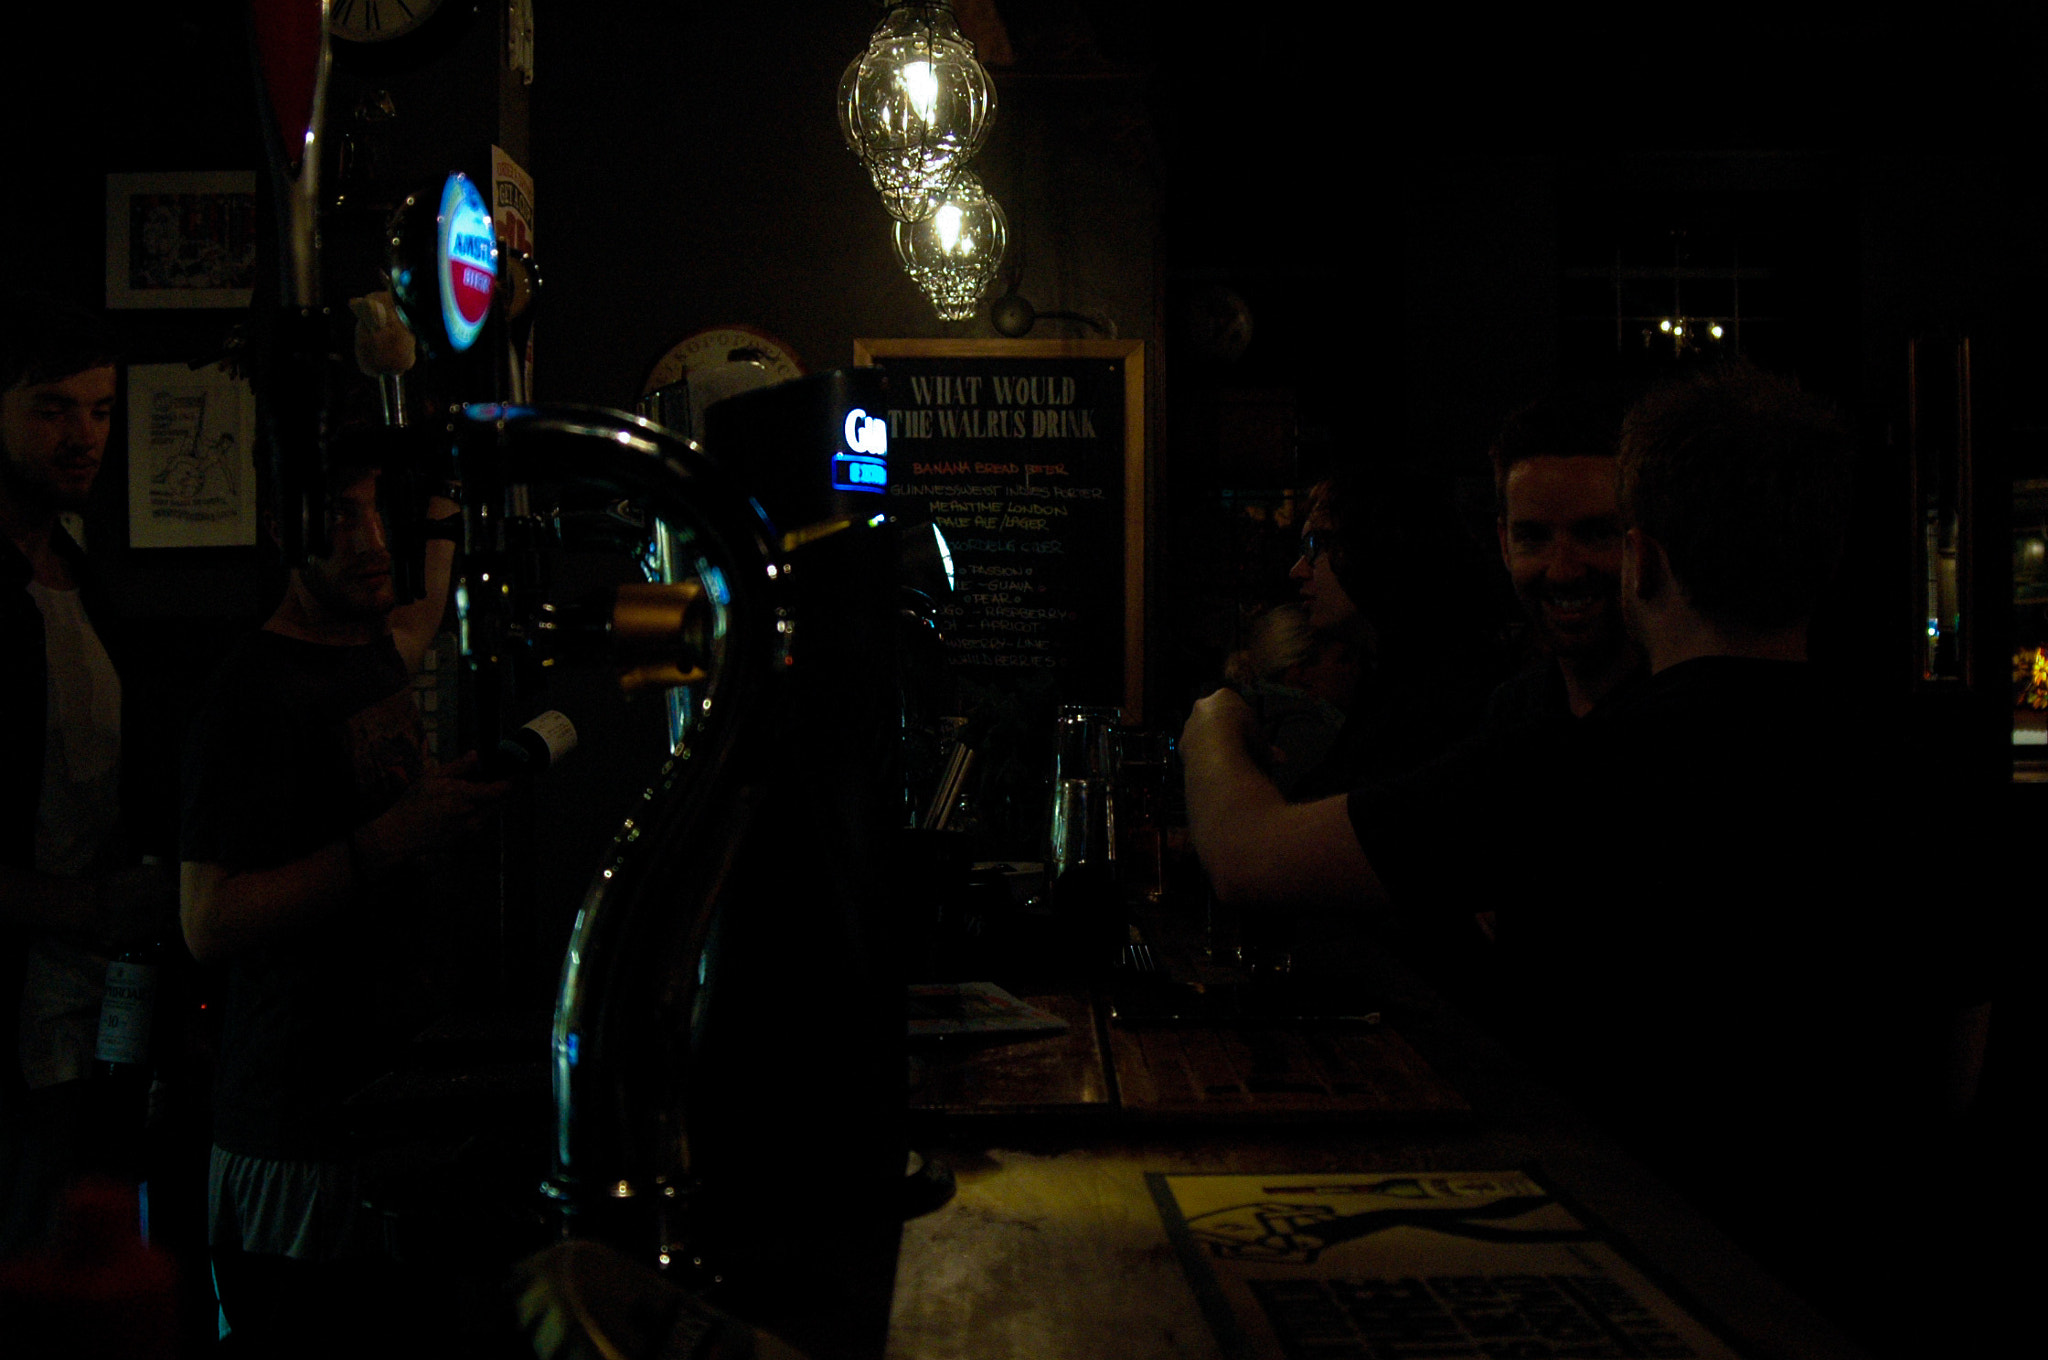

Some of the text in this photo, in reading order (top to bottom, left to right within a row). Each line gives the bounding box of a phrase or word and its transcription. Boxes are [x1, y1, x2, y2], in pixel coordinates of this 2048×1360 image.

[911, 376, 1076, 405] WHAT WOULD
[887, 409, 1097, 439] THE WALRUS DRINK
[912, 461, 971, 476] BANANA
[974, 461, 1019, 475] BREAD
[930, 500, 1068, 516] MEANTIME LONDON
[974, 515, 998, 530] ALE
[972, 592, 1012, 605] PEAR
[980, 619, 1041, 633] APRICOT
